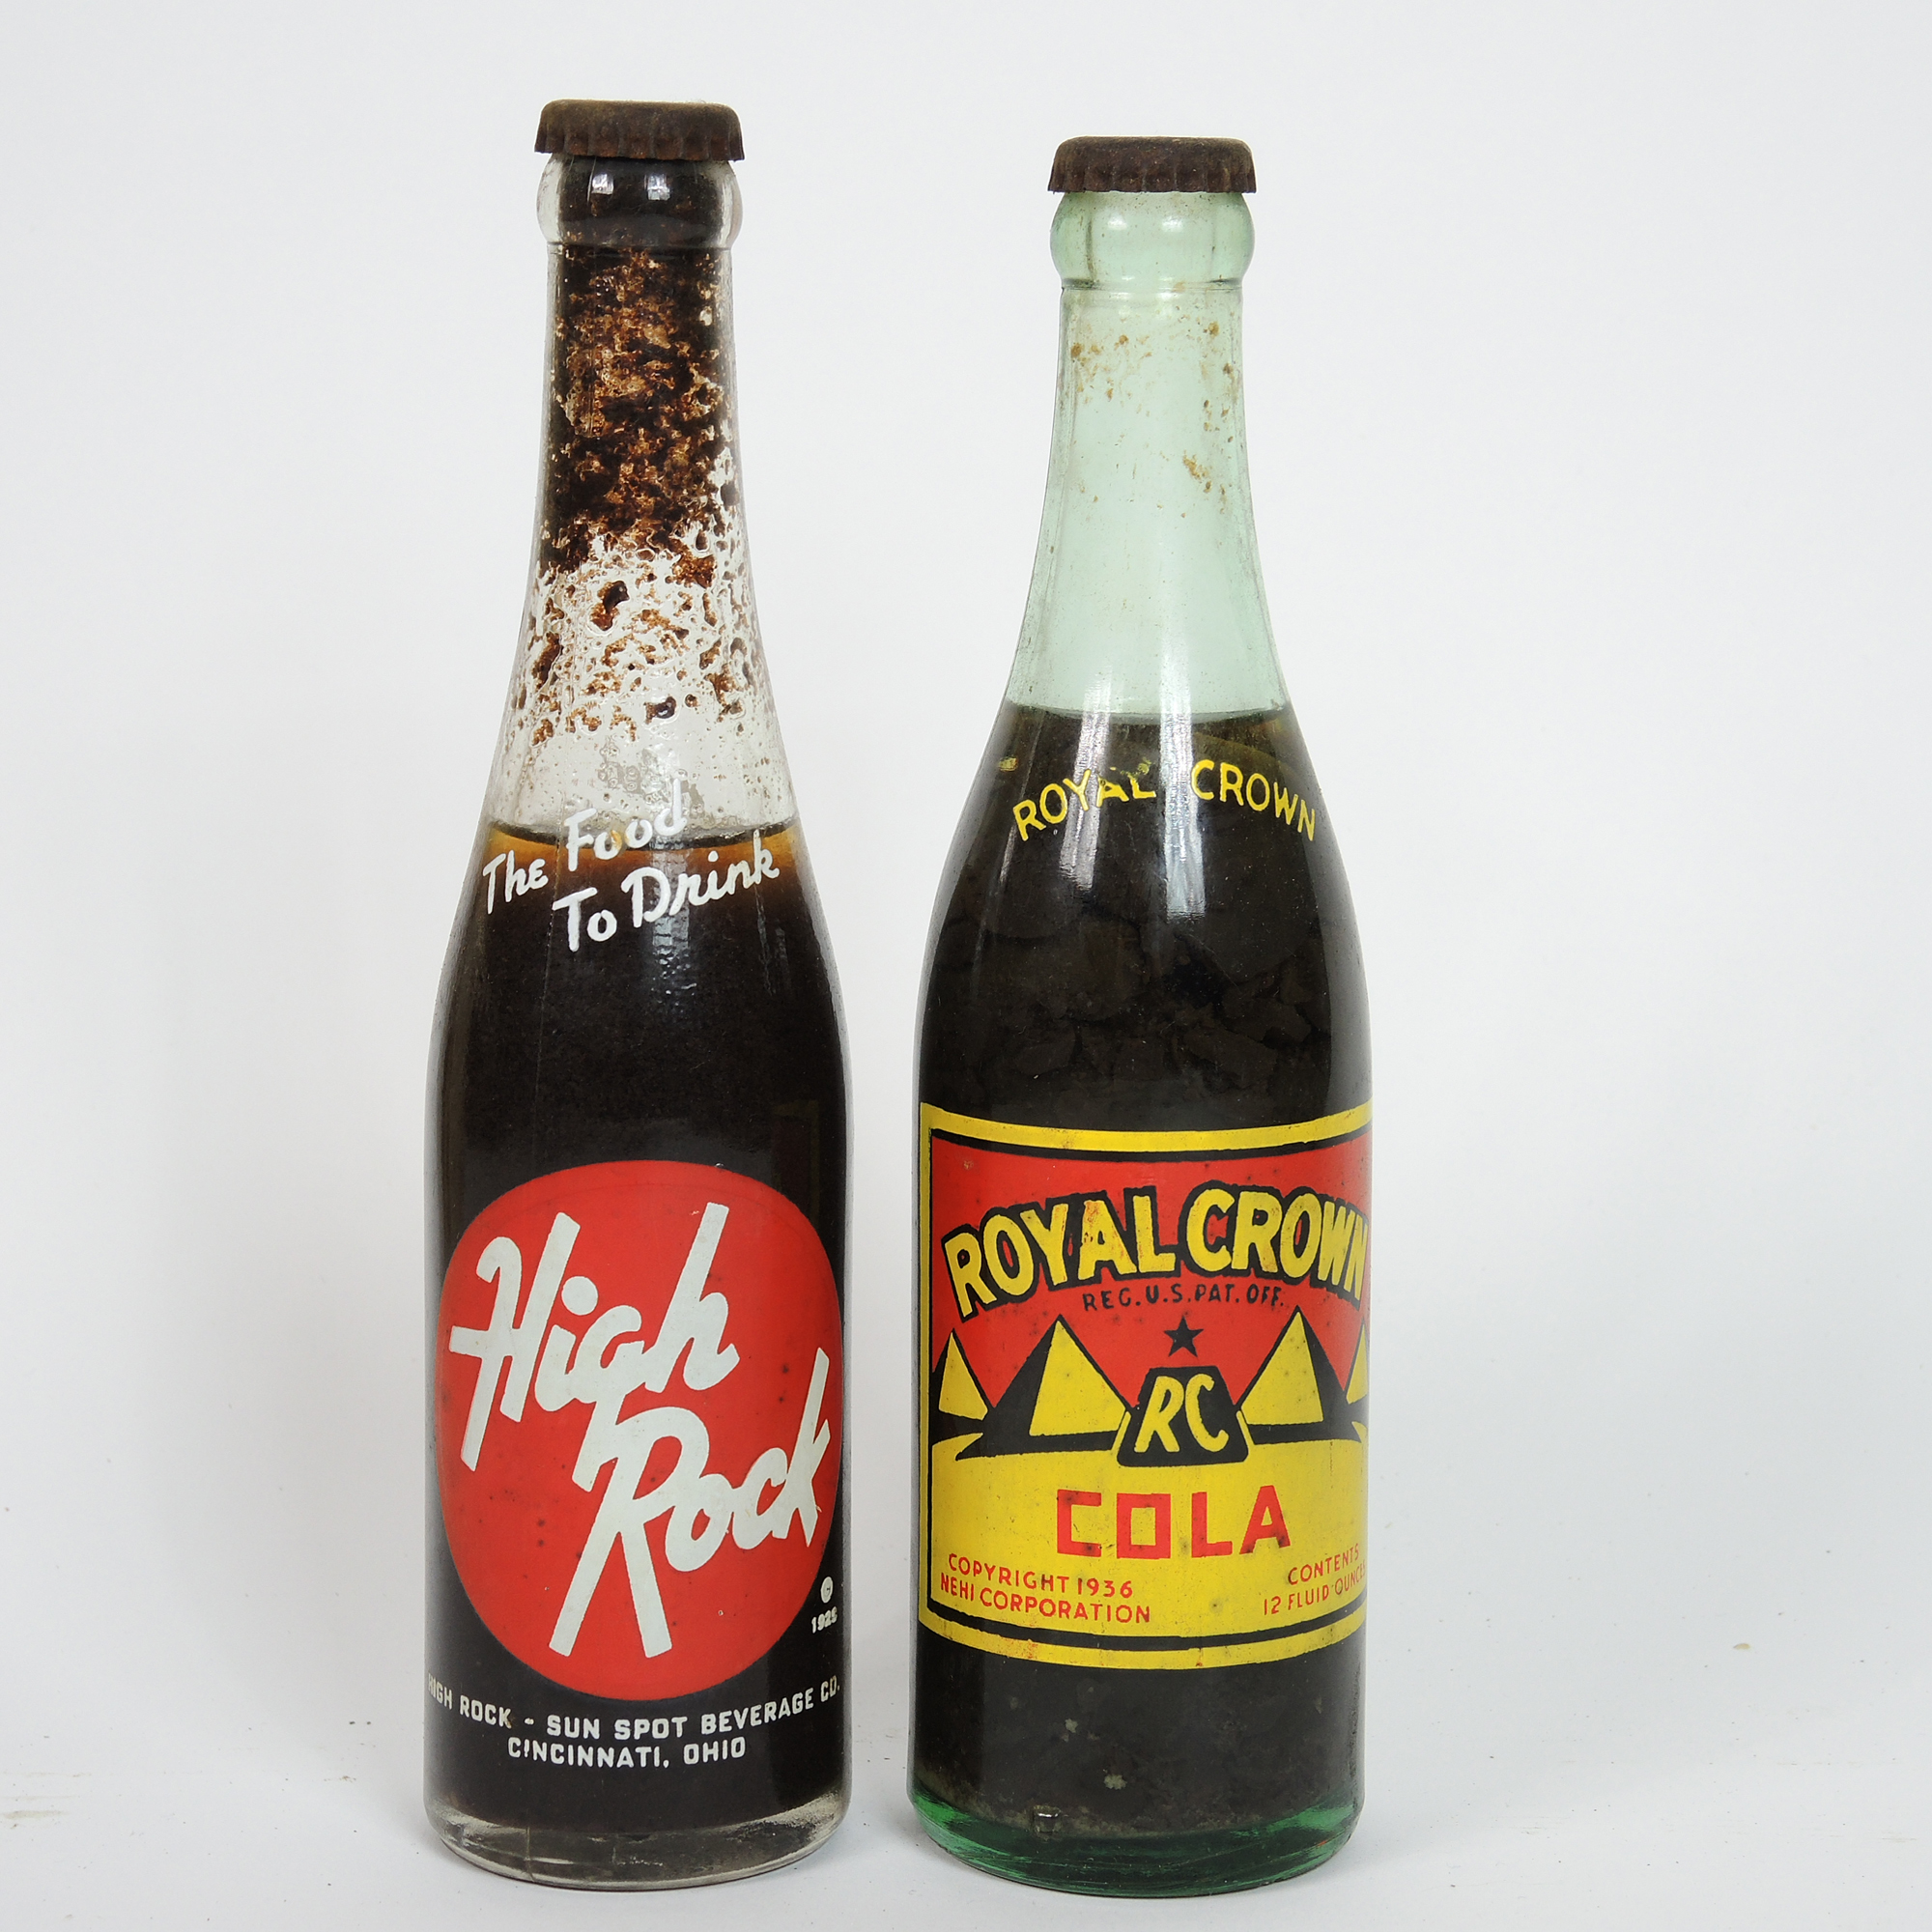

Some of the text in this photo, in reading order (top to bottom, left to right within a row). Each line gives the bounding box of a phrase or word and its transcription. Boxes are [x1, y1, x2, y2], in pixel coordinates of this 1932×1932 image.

[1012, 759, 1316, 841] ROYAL CROWN
[483, 779, 687, 914] The Food
[553, 830, 780, 952] To Drink
[943, 1188, 1368, 1319] ROYAL CROWN
[449, 1202, 740, 1488] High
[1133, 1373, 1231, 1453] RC
[549, 1347, 831, 1658] Rock
[1057, 1485, 1291, 1559] COLA
[940, 1572, 1151, 1623] NEHI CORPORATION
[949, 1553, 1133, 1599] COPYRIGHT 1936
[1264, 1596, 1282, 1615] 12
[1288, 1584, 1329, 1610] FLUID
[1288, 1543, 1359, 1585] CONTENTS
[459, 1694, 512, 1729] ROCK
[546, 1717, 601, 1740] SUN
[614, 1716, 688, 1740] SPOT
[700, 1687, 814, 1735] BEVERAGE
[508, 1737, 746, 1769] CINCINNATI, OHIO
